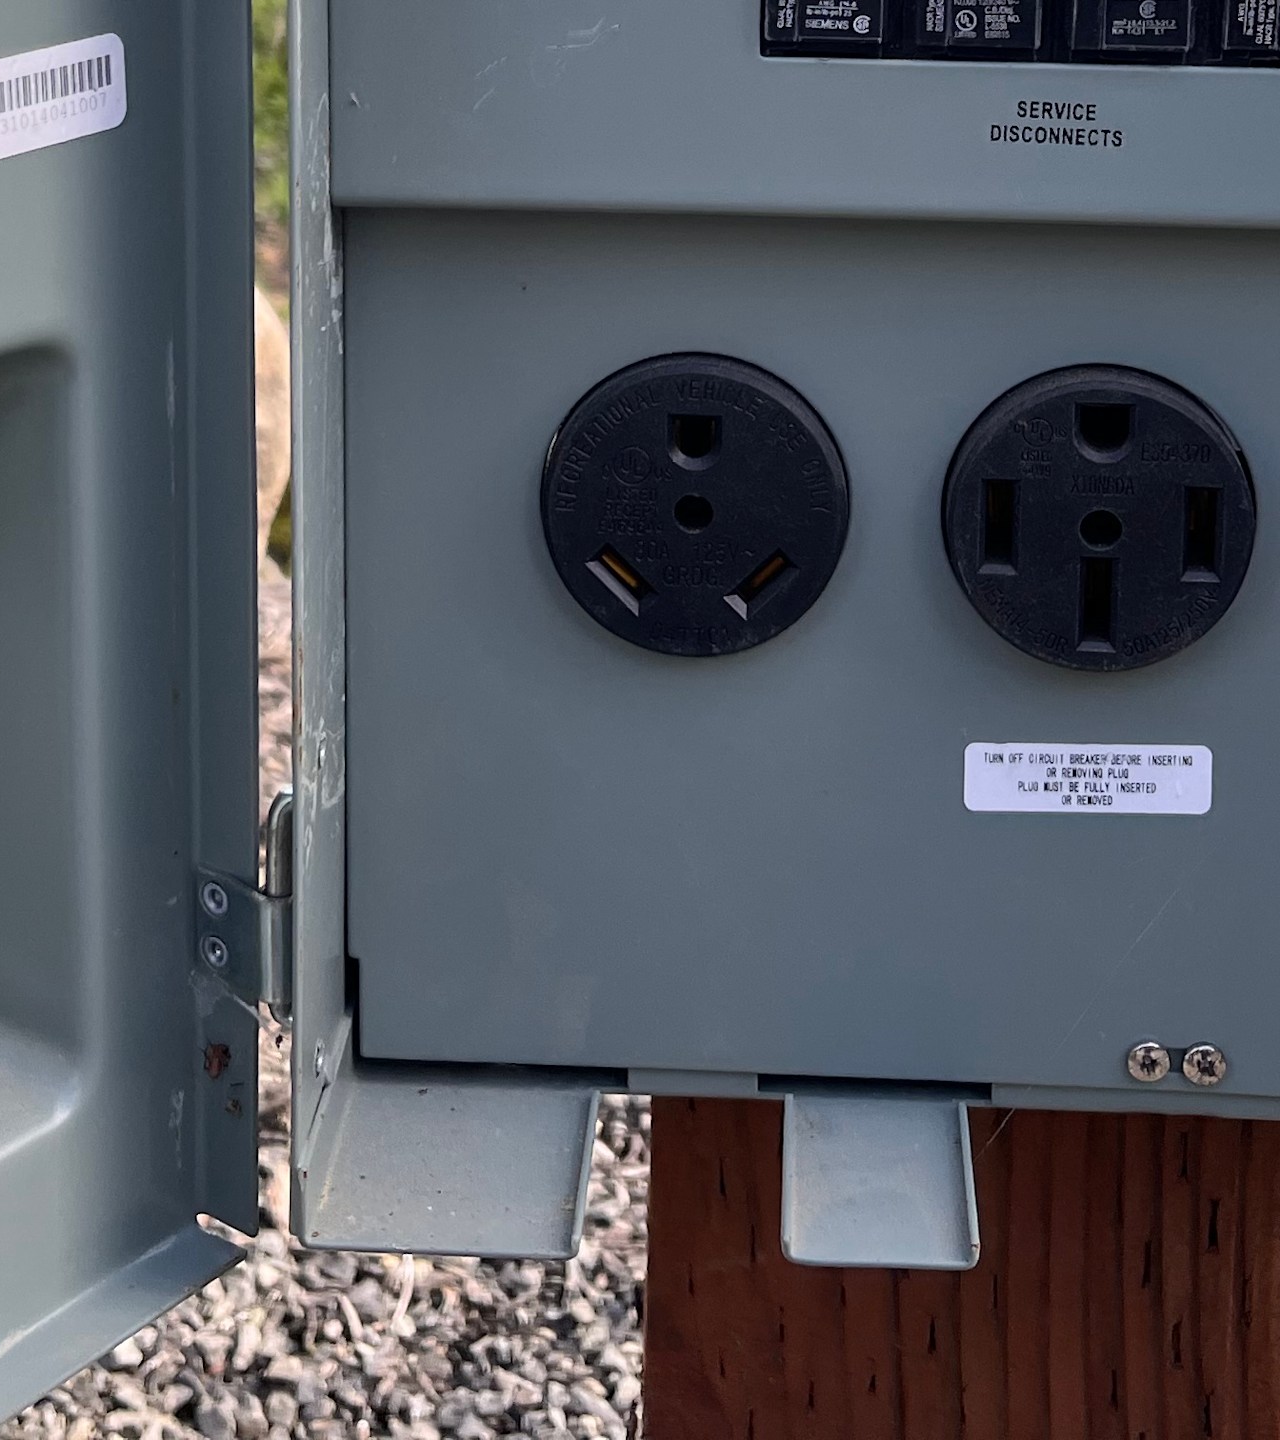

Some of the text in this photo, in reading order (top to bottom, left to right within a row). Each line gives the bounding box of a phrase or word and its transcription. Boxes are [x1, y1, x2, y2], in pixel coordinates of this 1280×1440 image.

[805, 18, 850, 30] SIEMENS
[1016, 100, 1097, 122] SERVICE
[990, 124, 1123, 148] DISCONNECTS
[984, 752, 1004, 764] TURN
[1008, 752, 1024, 764] OFF
[1028, 753, 1064, 765] CIRCUIT
[1046, 767, 1129, 779] OR REMOVING PLUG
[1017, 780, 1157, 794] PLUG MUST BE FULLY INSERTED
[1061, 794, 1113, 806] OR REMOVED
